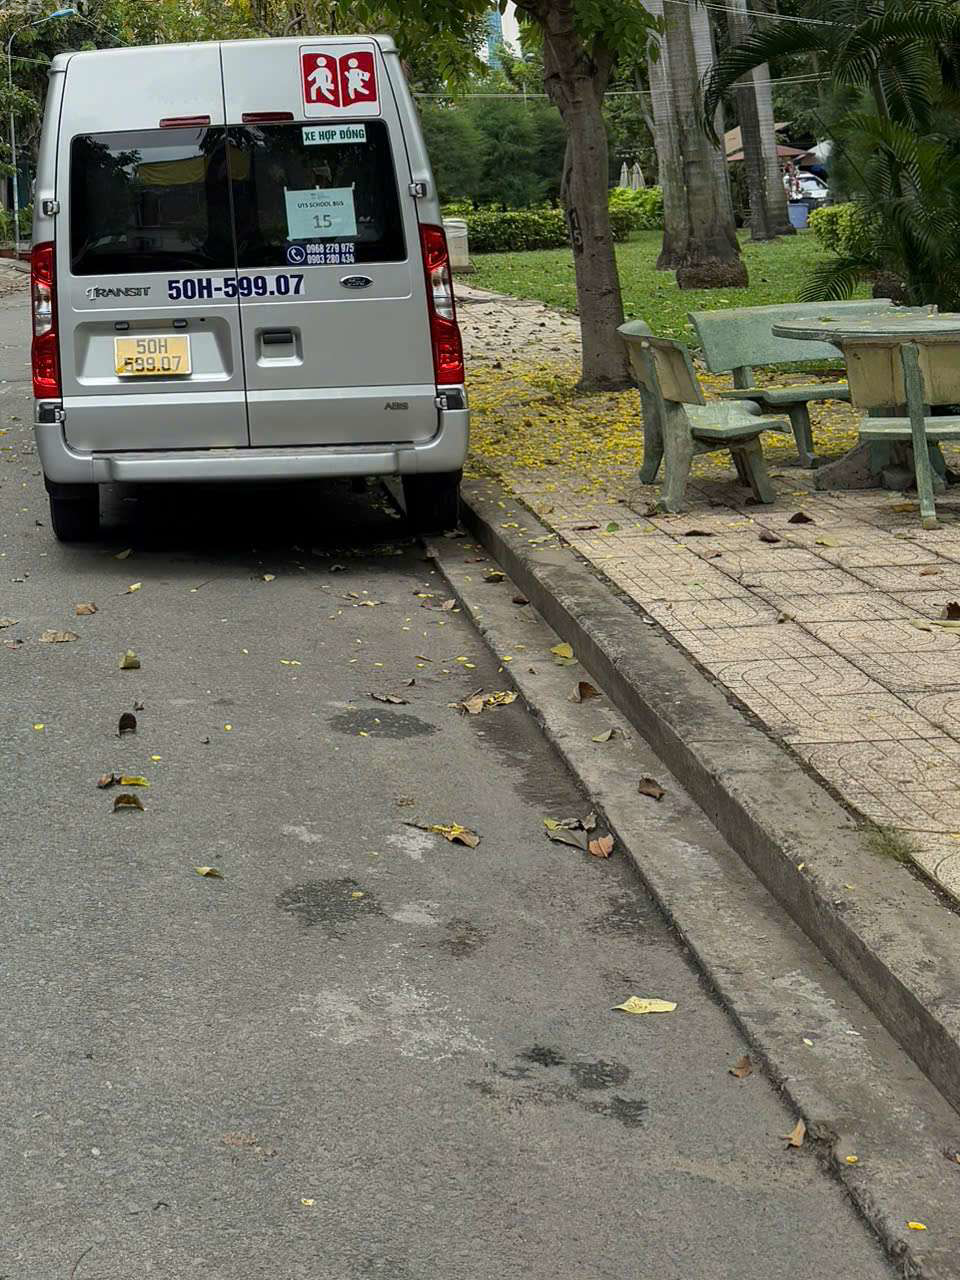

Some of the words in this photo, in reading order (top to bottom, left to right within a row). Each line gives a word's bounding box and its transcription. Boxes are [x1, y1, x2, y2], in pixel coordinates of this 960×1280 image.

[304, 131, 316, 142] XE
[319, 129, 337, 142] HỢP
[312, 214, 332, 229] 15
[326, 243, 340, 253] 279
[341, 242, 355, 253] 975
[341, 253, 355, 263] 434
[85, 285, 152, 301] TRANSIT
[167, 273, 305, 301] 50H-599.07
[136, 337, 169, 355] 50H
[123, 354, 182, 373] 599.07
